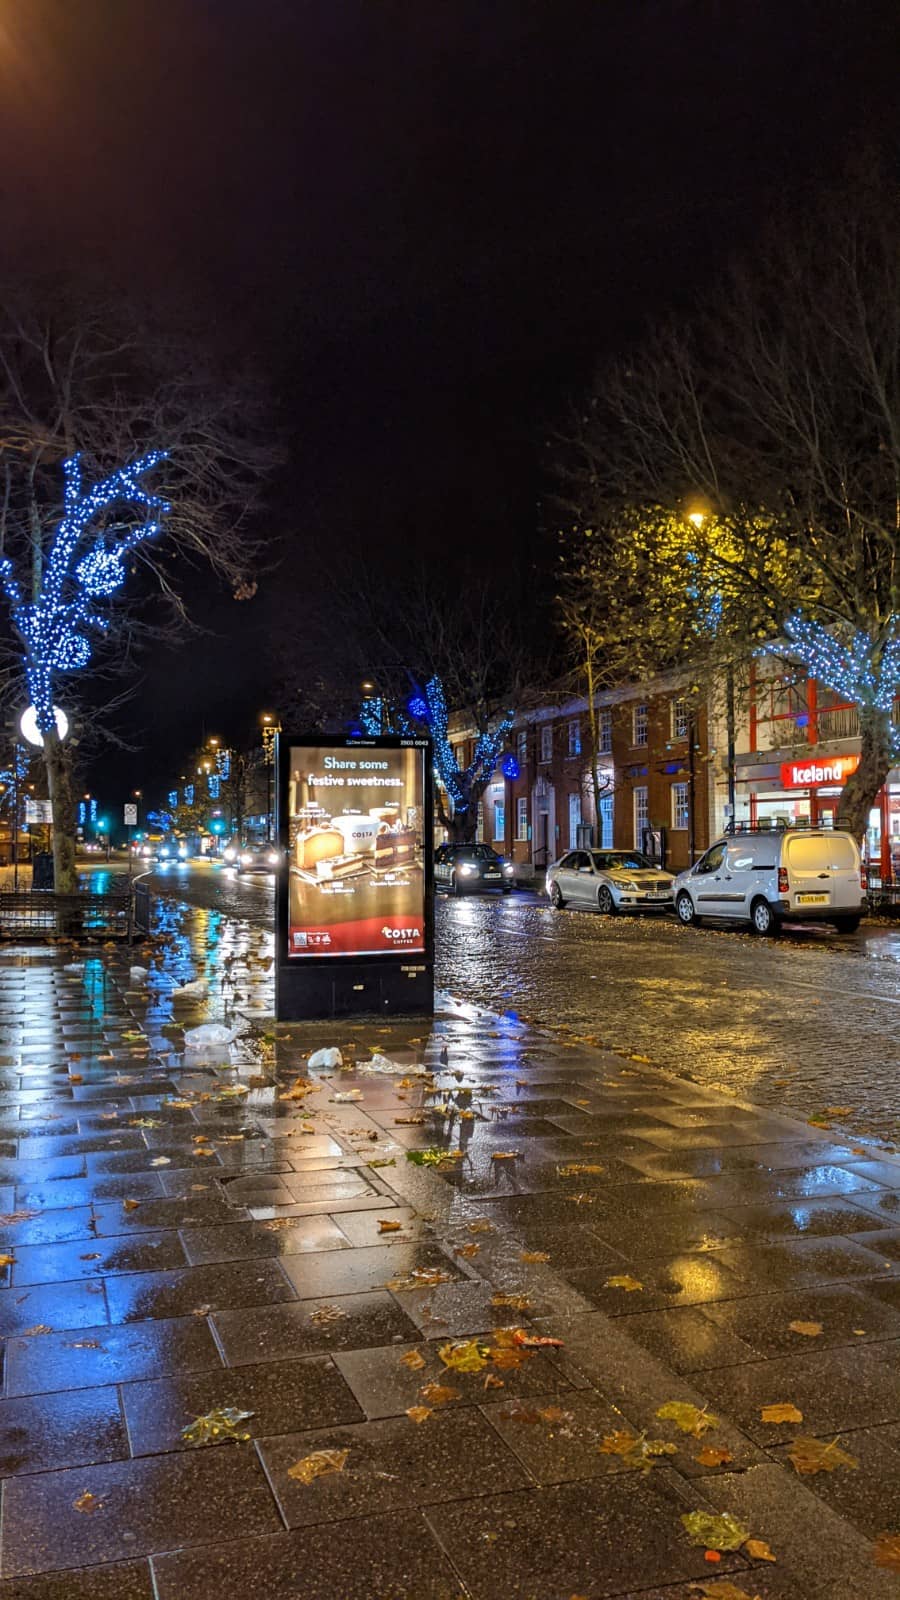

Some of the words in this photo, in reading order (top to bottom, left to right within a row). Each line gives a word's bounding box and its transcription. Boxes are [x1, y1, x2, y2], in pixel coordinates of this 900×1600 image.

[324, 757, 356, 769] Share
[359, 761, 388, 769] some
[793, 762, 842, 783] Iceland
[307, 774, 345, 786] festive
[347, 775, 404, 786] sweetness.
[385, 928, 420, 938] COSTA
